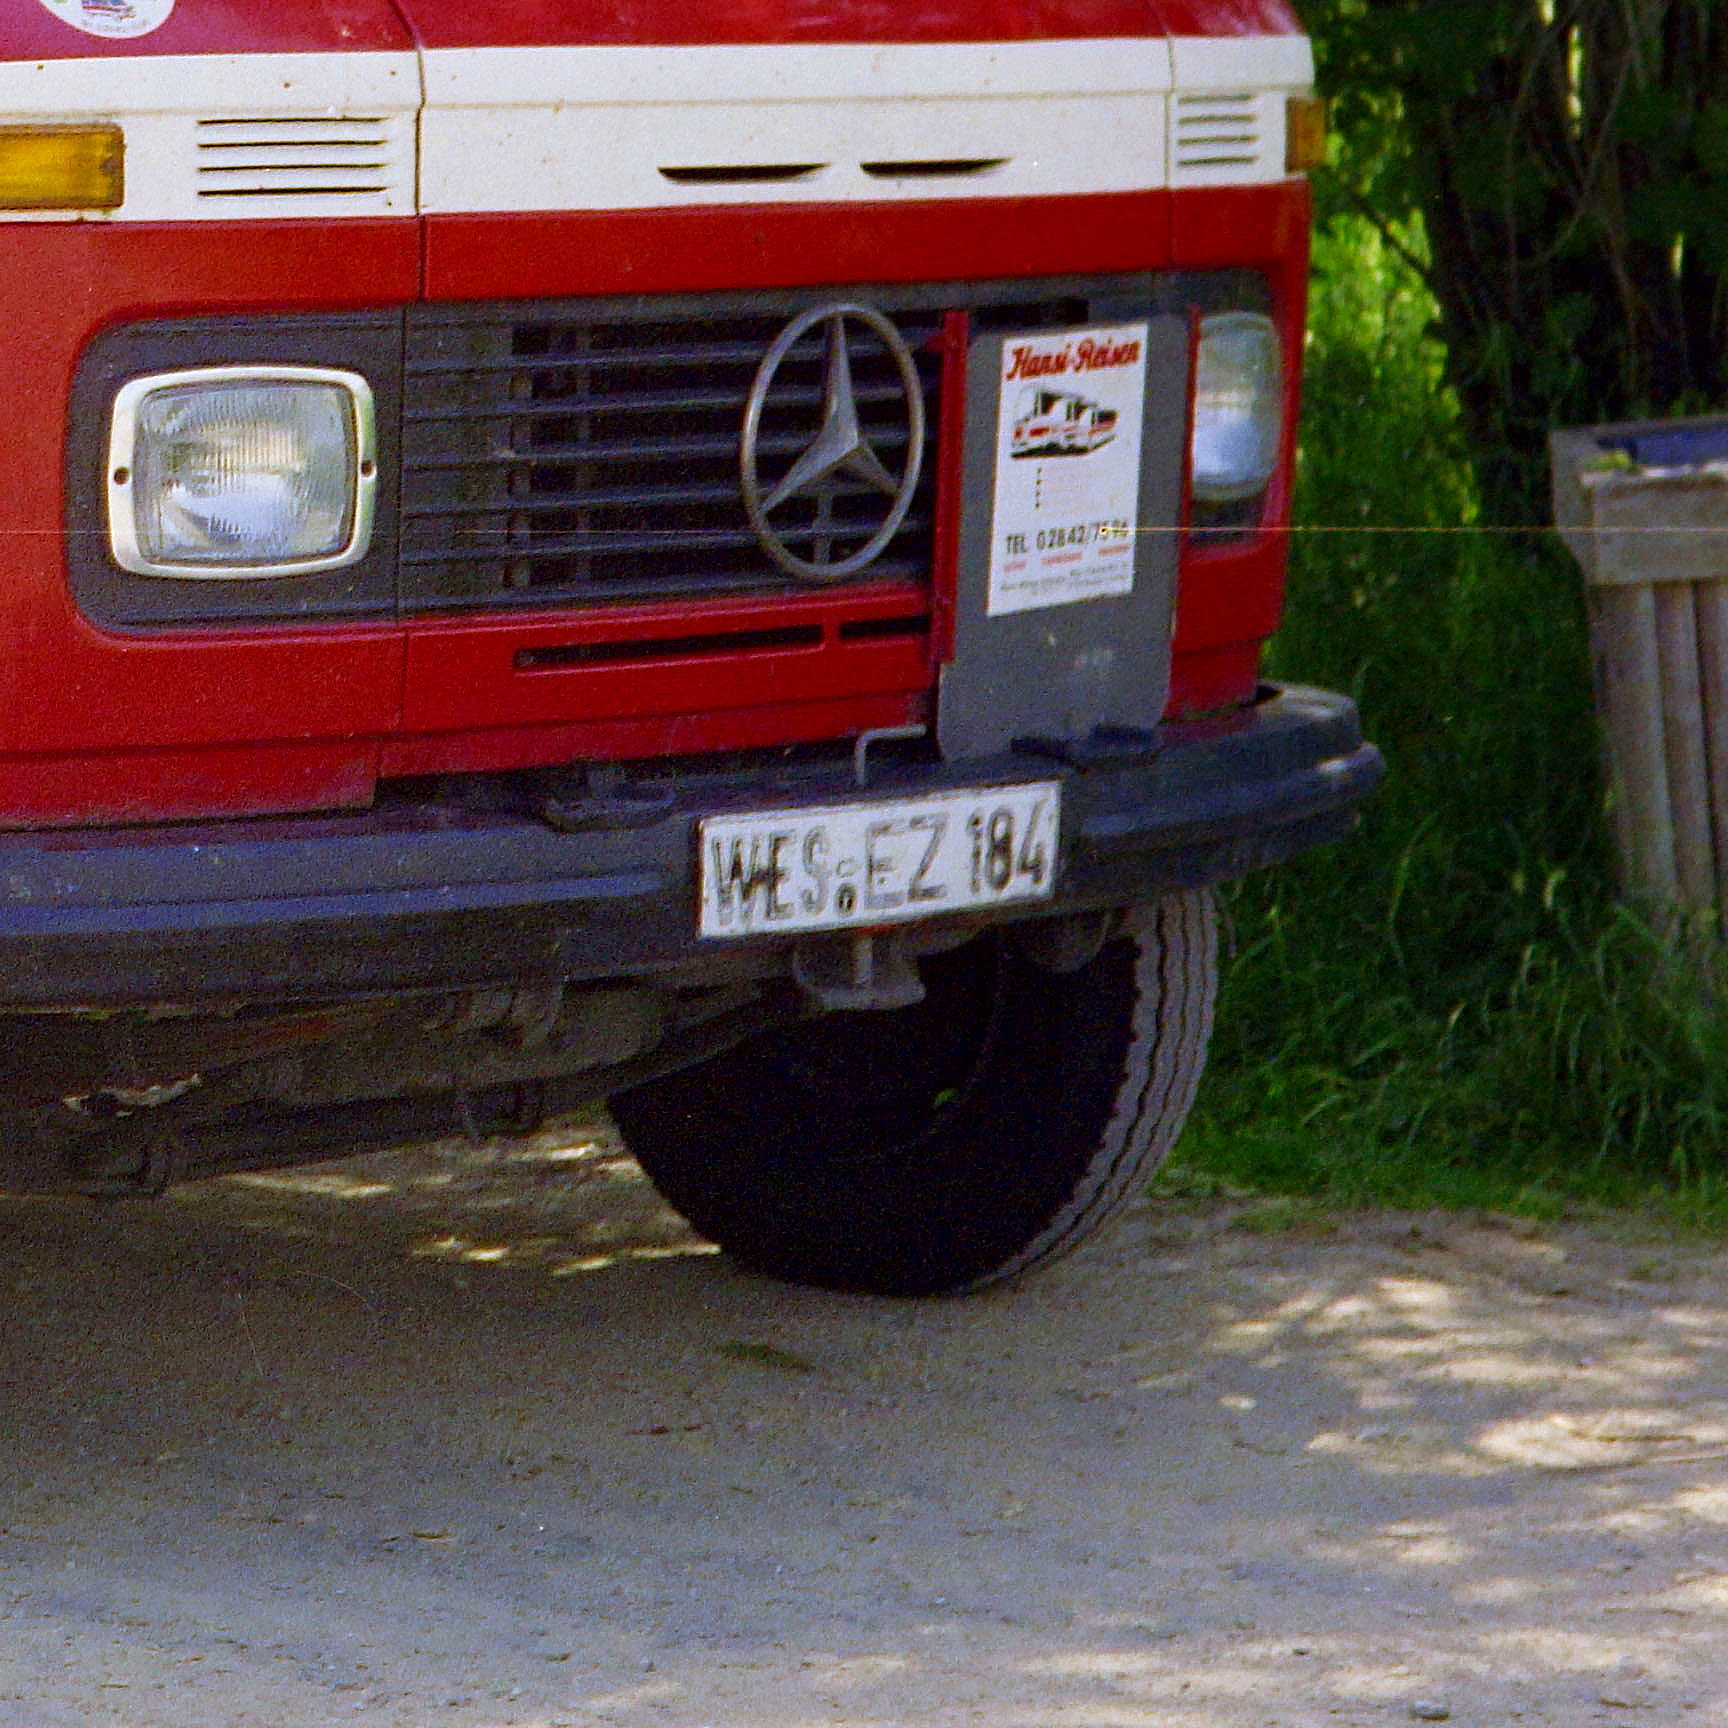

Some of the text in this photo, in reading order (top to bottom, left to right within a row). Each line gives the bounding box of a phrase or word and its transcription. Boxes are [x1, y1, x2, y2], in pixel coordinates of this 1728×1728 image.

[1005, 336, 1141, 382] Hansi-Reisen
[711, 799, 1050, 928] WES EZ 184
